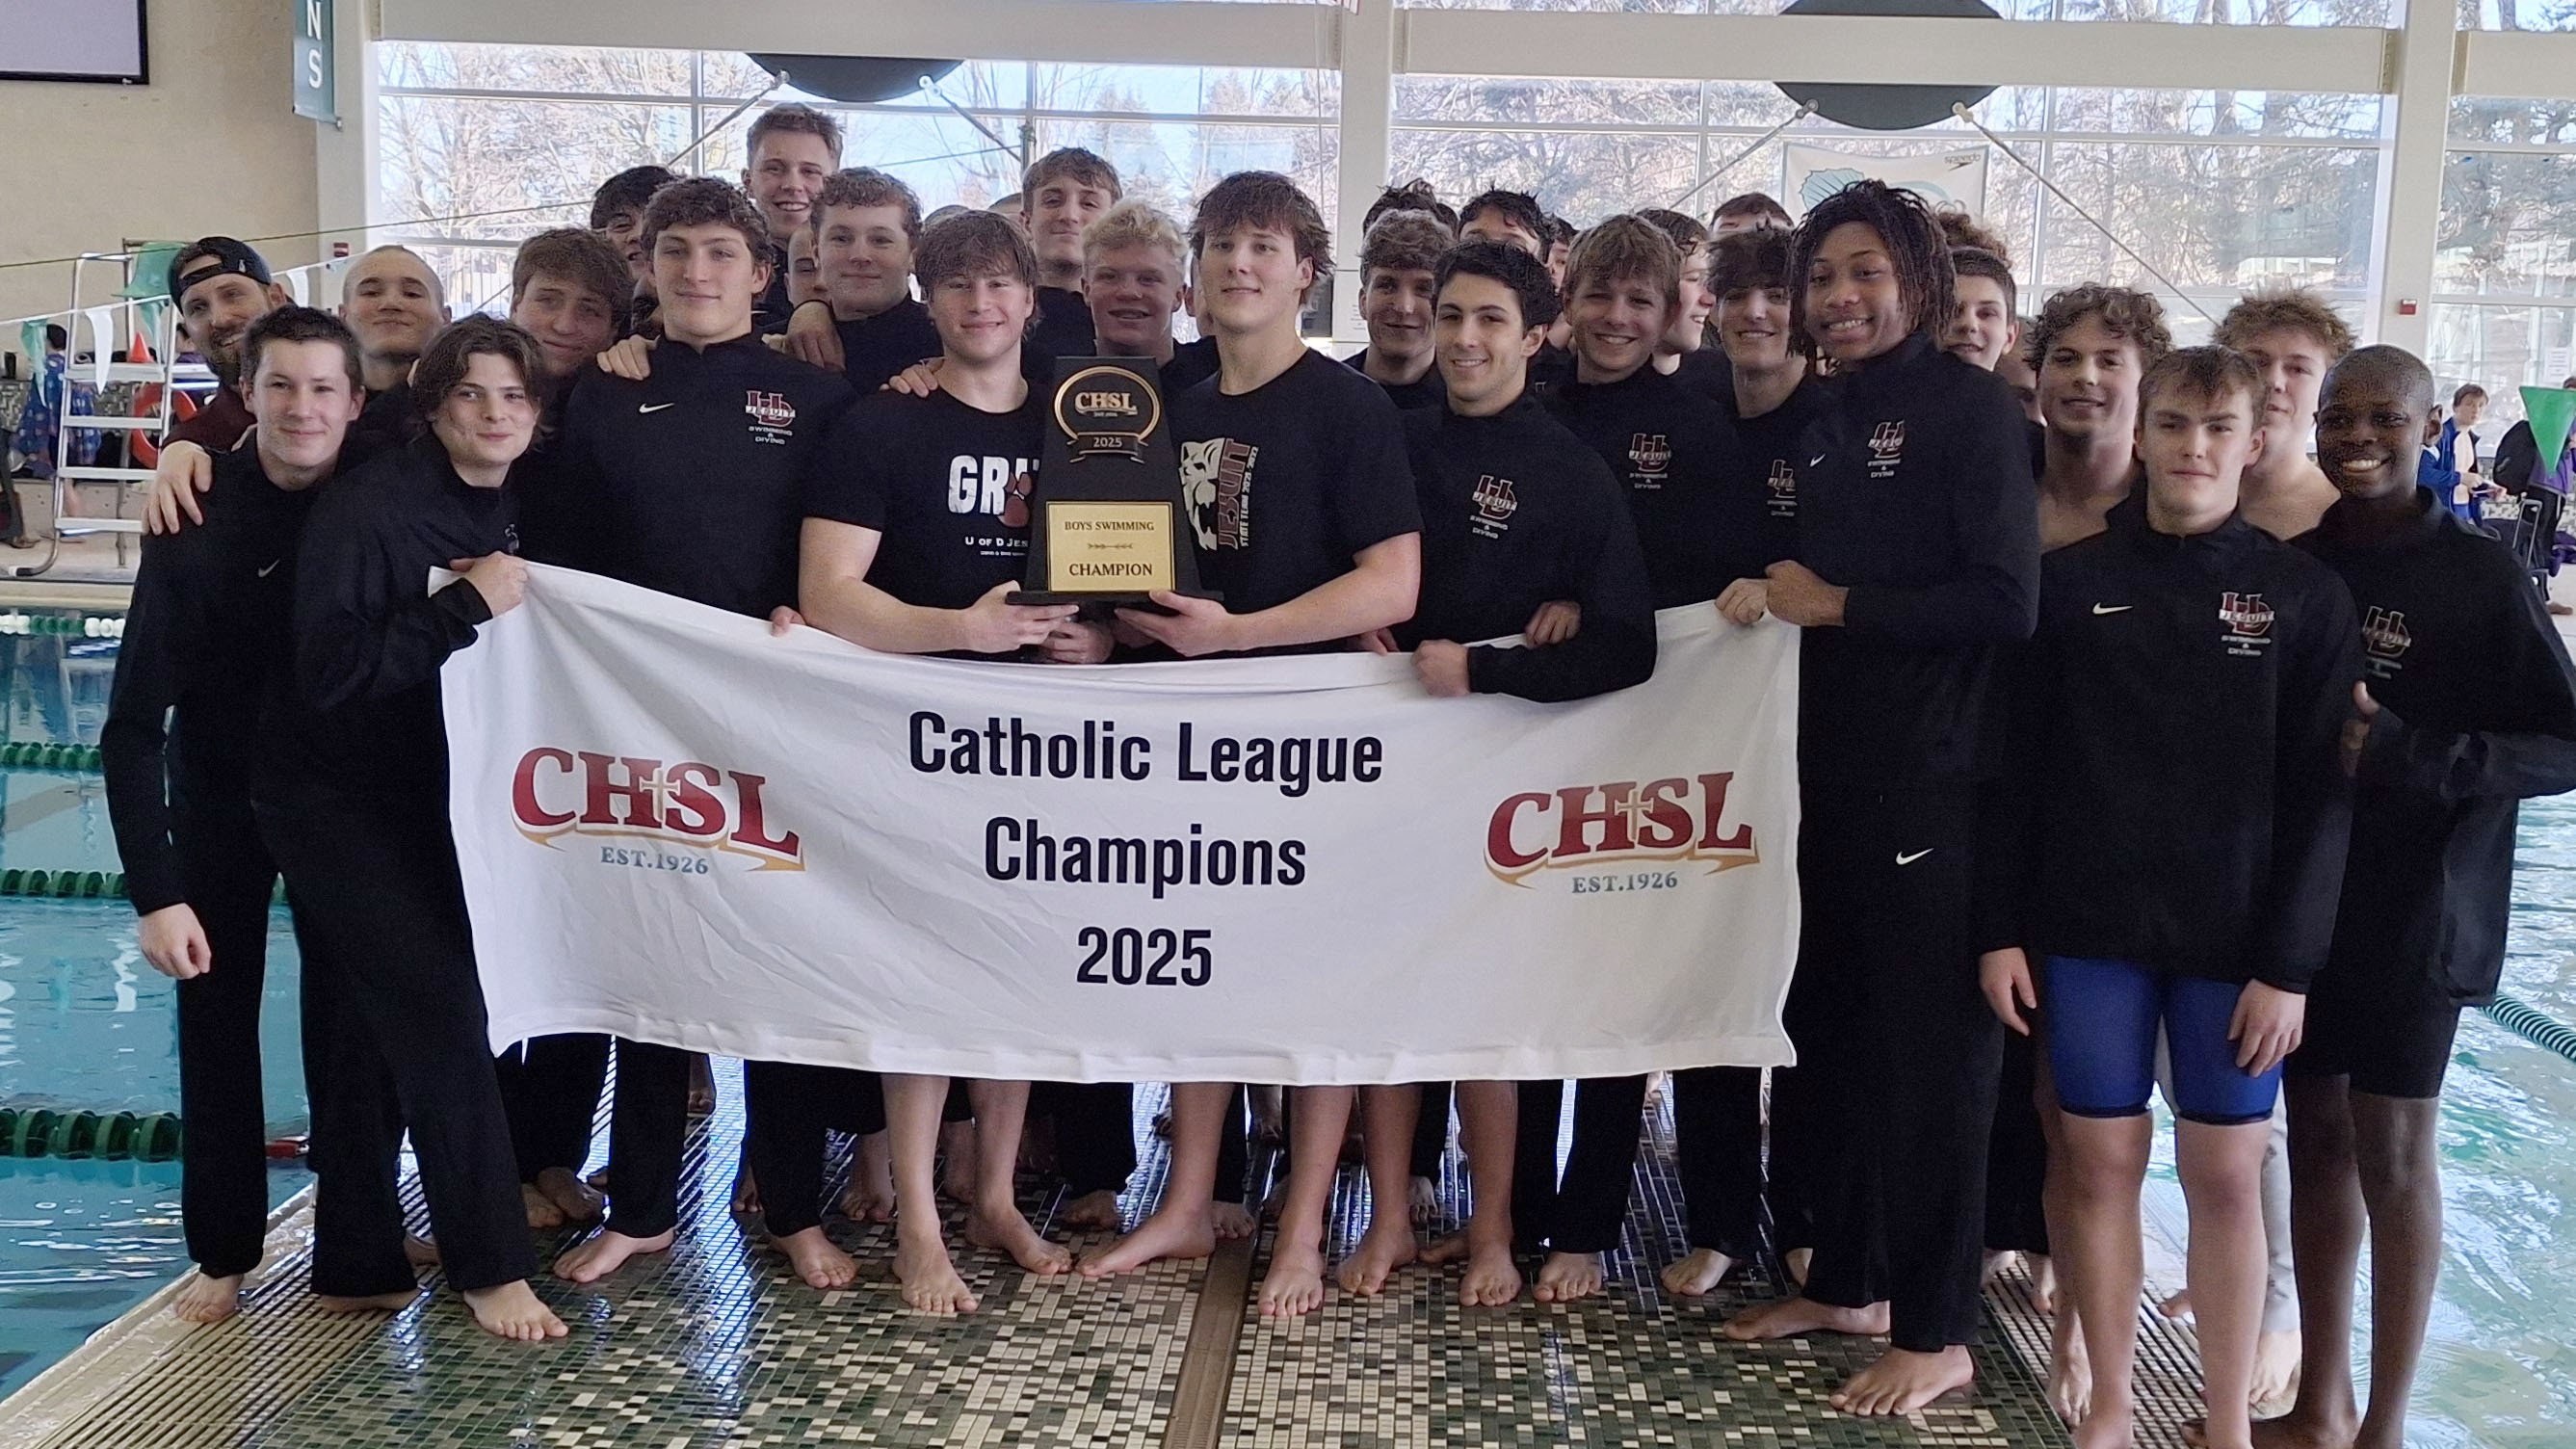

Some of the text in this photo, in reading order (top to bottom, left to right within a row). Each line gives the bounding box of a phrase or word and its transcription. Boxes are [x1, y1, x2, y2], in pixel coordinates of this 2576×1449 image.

[1074, 391, 1138, 410] CHSL
[1092, 436, 1123, 448] 2025
[1218, 438, 1250, 550] JESUIT
[1065, 521, 1155, 531] BOYS SWIMMING
[964, 537, 975, 545] U
[996, 538, 1004, 547] D
[1068, 563, 1153, 576] CHAMPION
[909, 711, 1383, 798] Catholic League
[512, 747, 800, 856] CHSL
[1487, 771, 1752, 868] CHSL
[600, 846, 709, 875] EST.1926
[986, 816, 1306, 899] Champions
[1571, 871, 1678, 894] EST.1926
[1076, 927, 1213, 988] 2025
